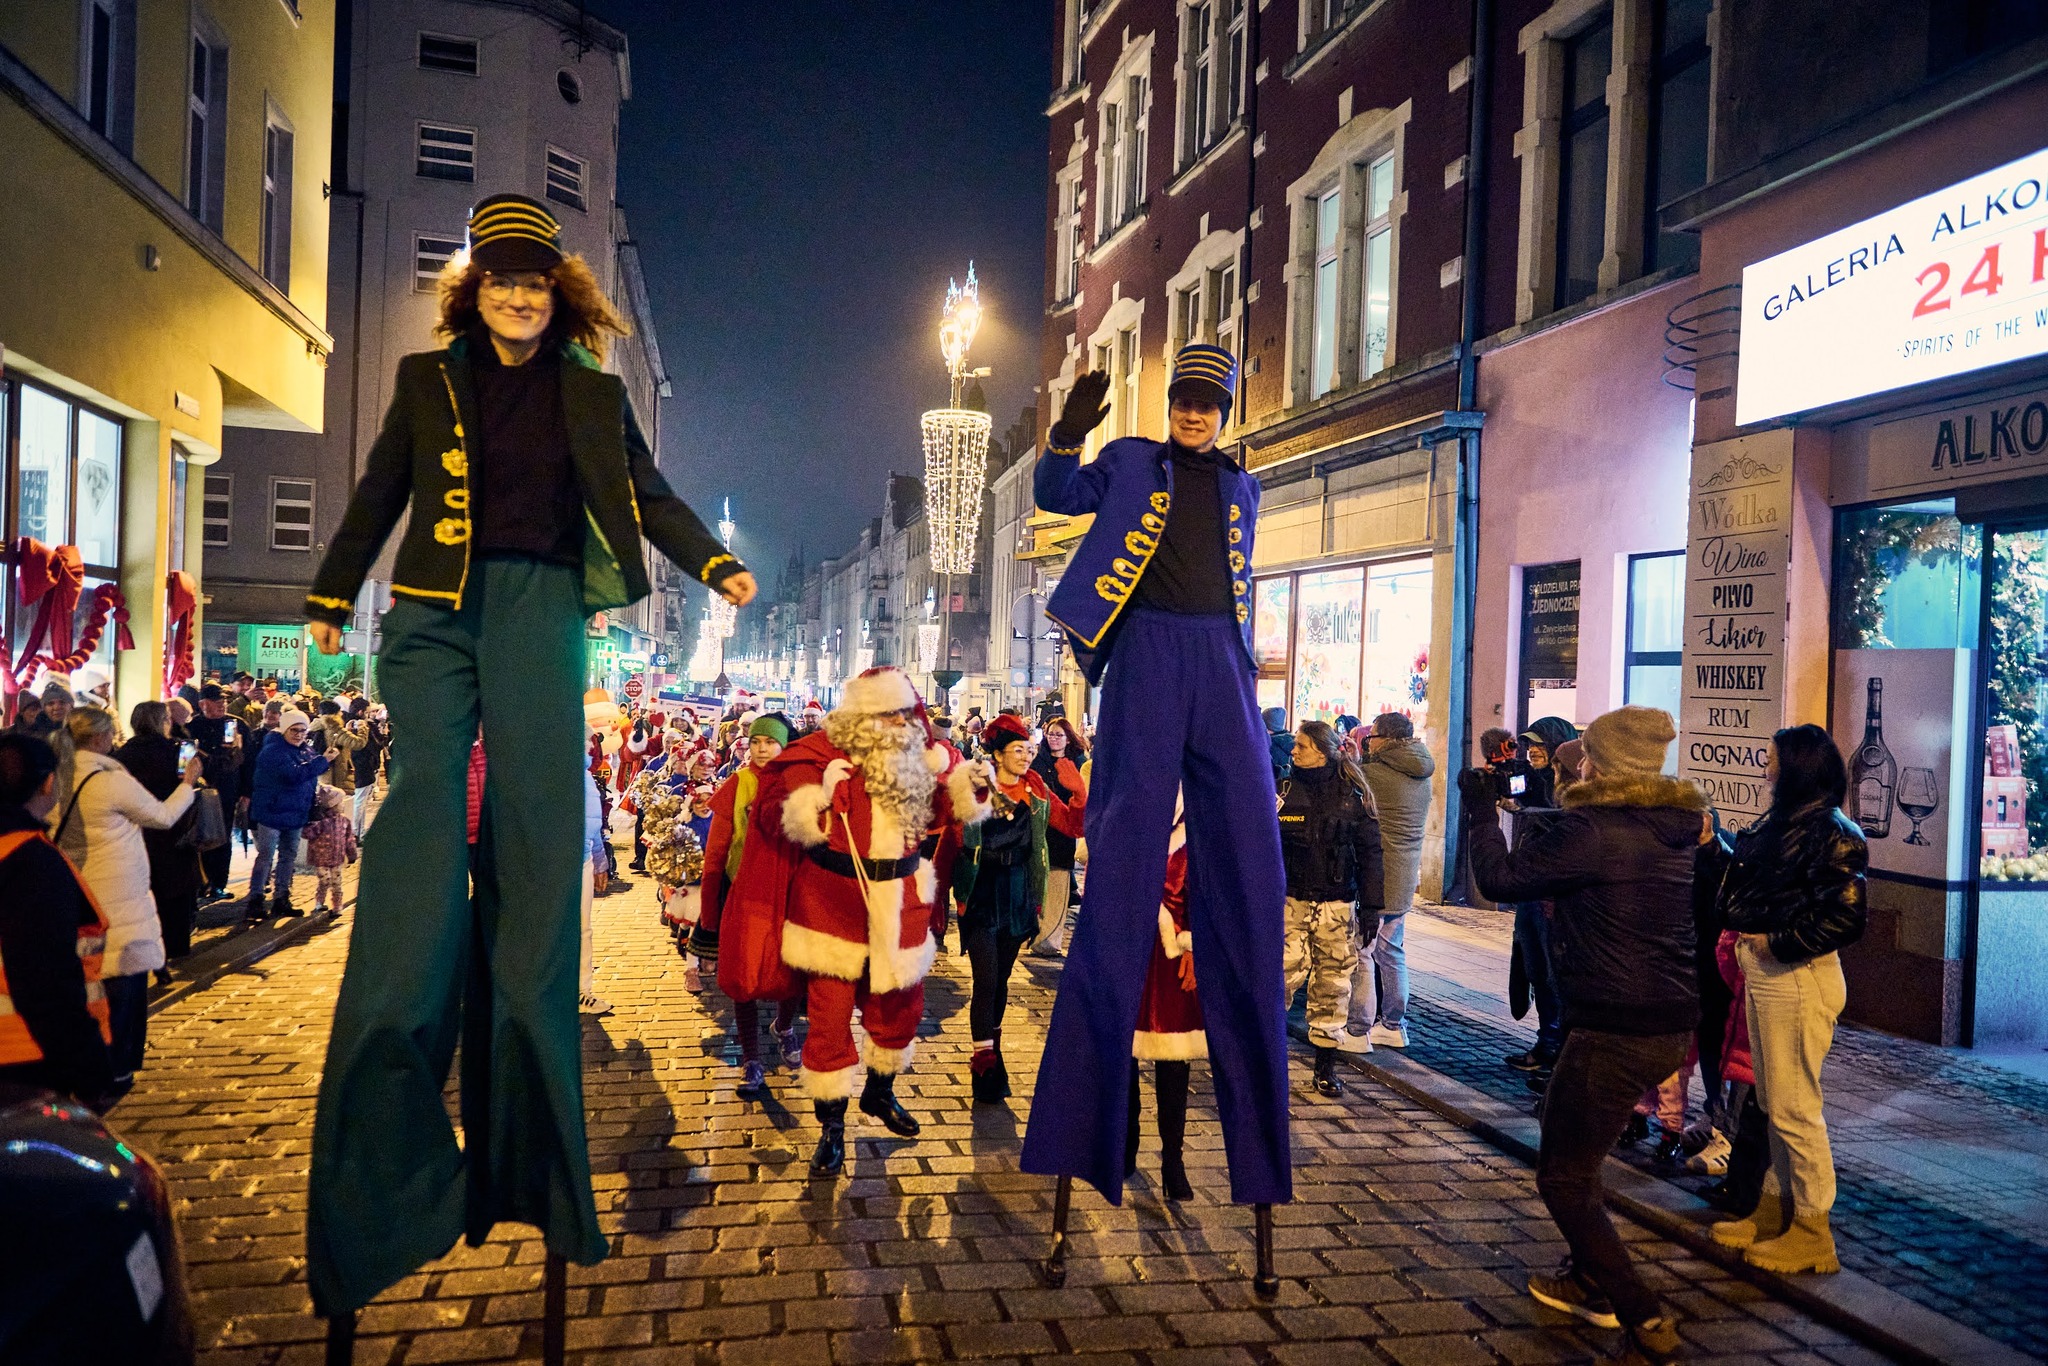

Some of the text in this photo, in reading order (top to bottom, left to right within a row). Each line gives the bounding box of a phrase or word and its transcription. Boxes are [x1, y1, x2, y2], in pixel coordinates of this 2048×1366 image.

[1763, 178, 2048, 321] GALERIA ALKO
[1911, 243, 2003, 321] 24
[1903, 333, 1954, 358] SPIRITS
[1965, 328, 1981, 348] OF
[1996, 316, 2022, 340] THE
[1698, 494, 1778, 530] Wódka
[1702, 537, 1769, 576] Wino
[1713, 583, 1753, 609] PIWO
[1698, 617, 1767, 650] Likier
[261, 650, 299, 659] APTEKA
[1696, 665, 1767, 690] WHISKEY
[1708, 707, 1750, 729] RUM
[1690, 742, 1768, 768] COGNAC
[1691, 777, 1763, 807] RANDY
